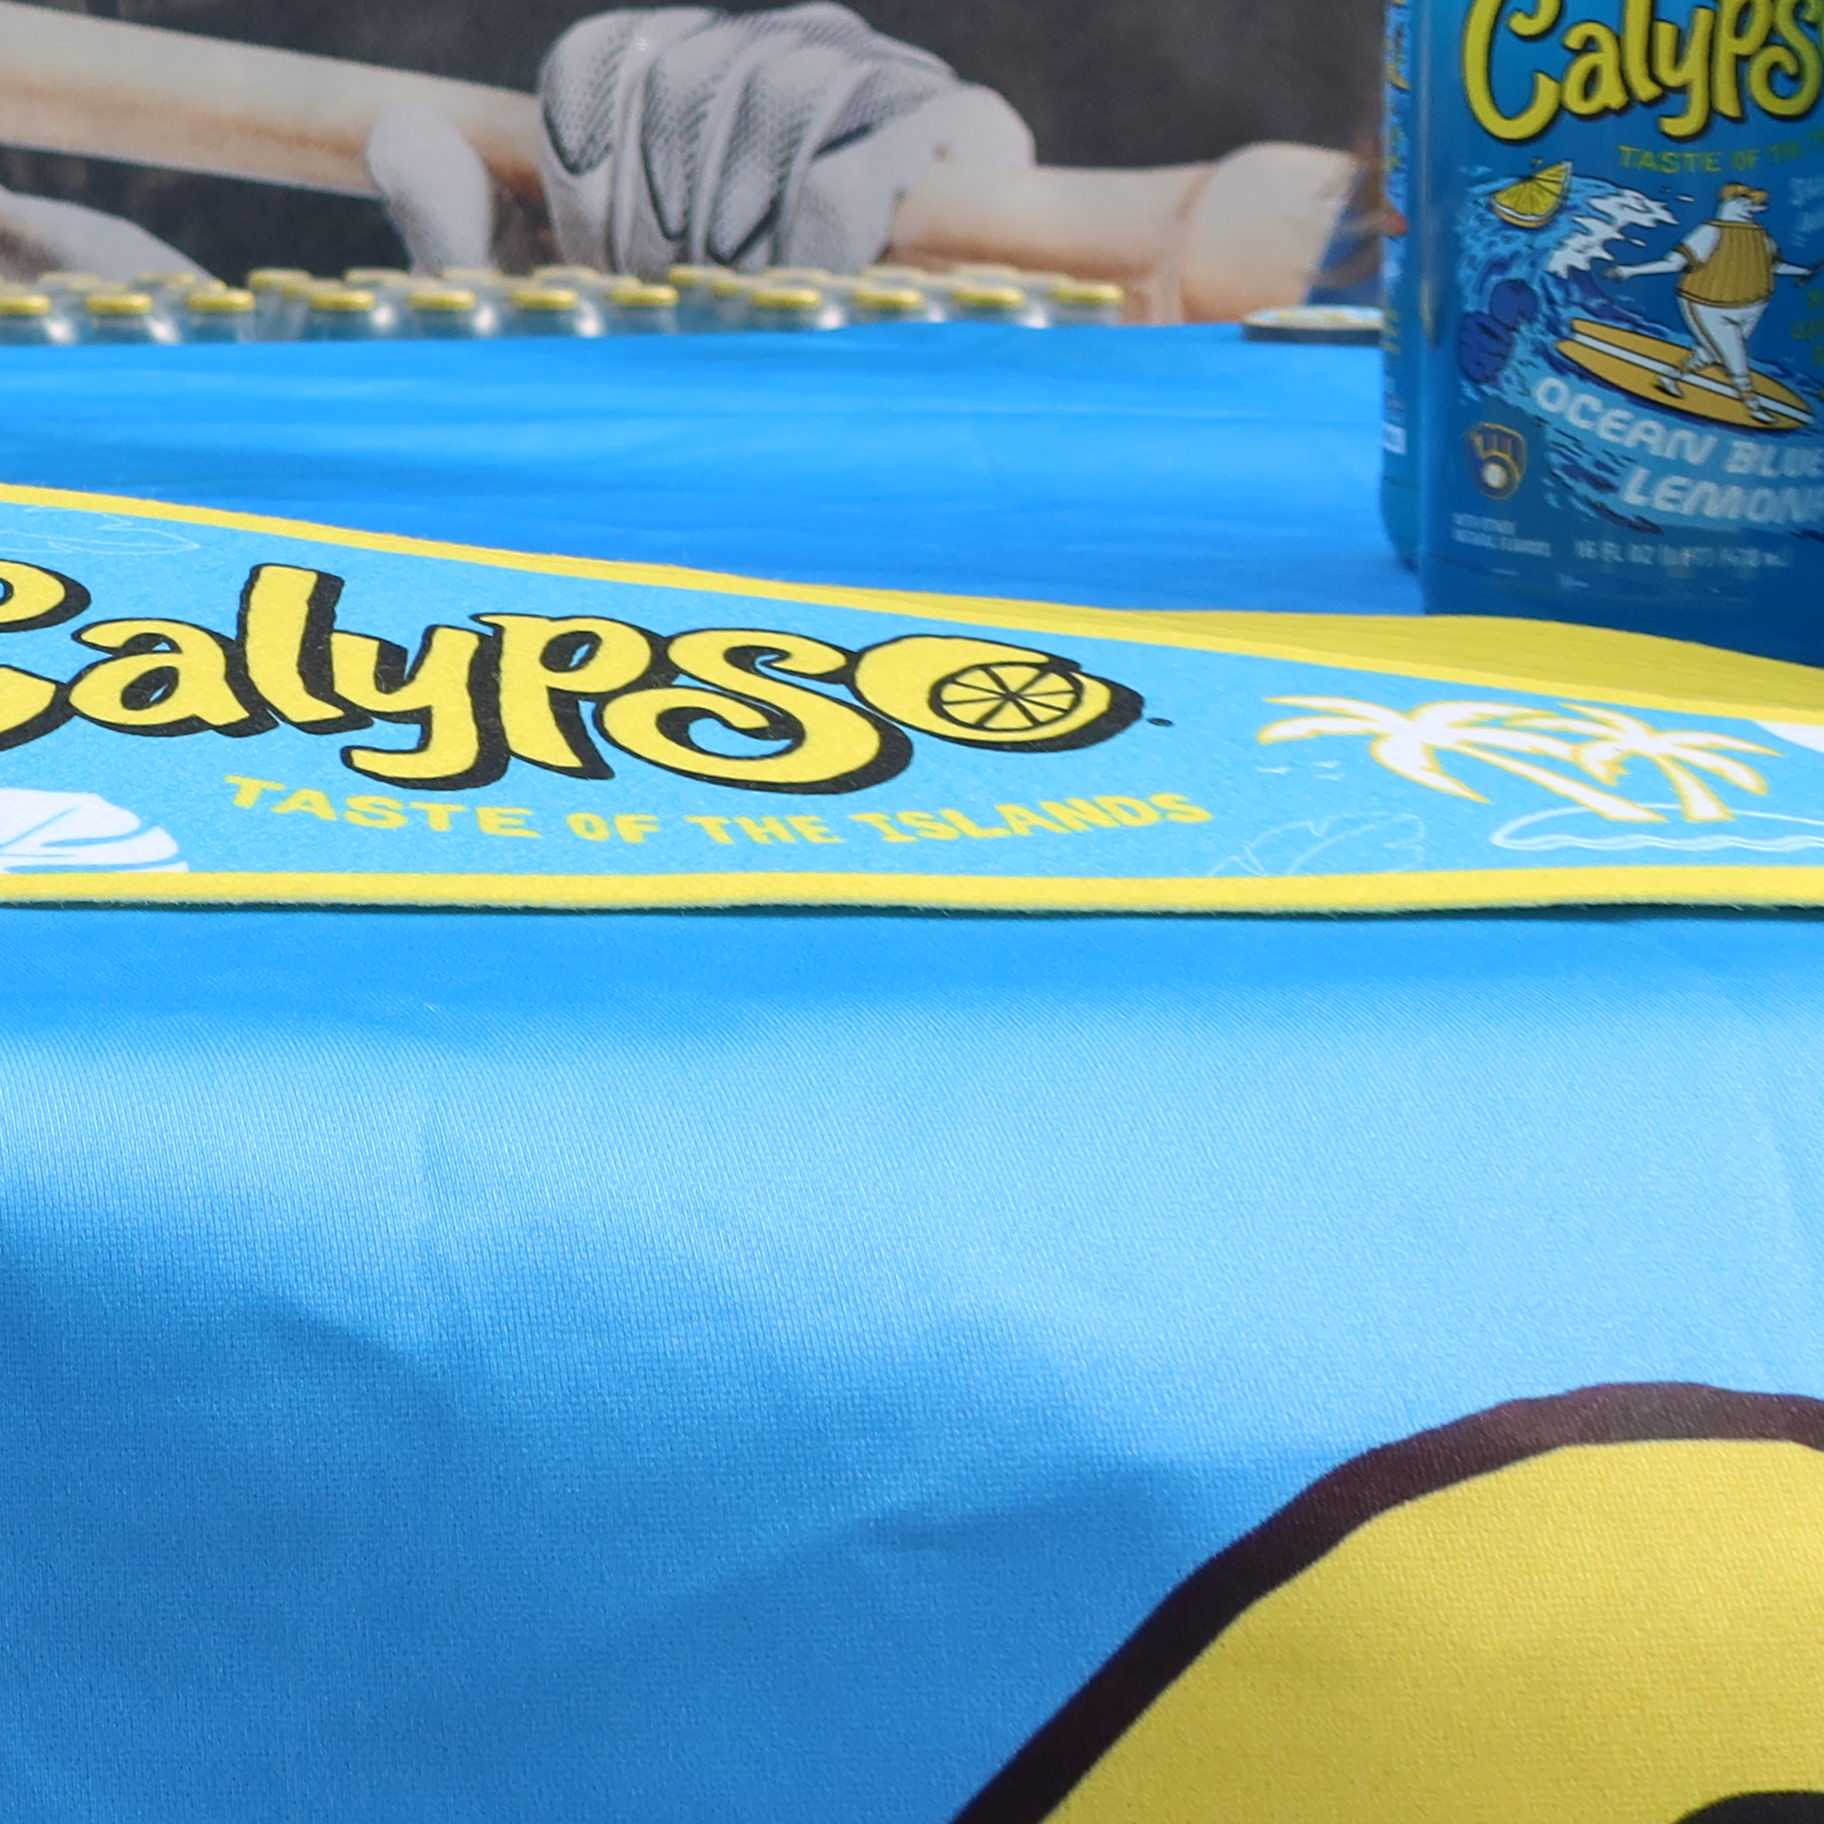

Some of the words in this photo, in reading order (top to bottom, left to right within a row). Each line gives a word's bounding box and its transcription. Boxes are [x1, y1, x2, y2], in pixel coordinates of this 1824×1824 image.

[1619, 144, 1722, 174] TASTE
[1533, 376, 1718, 466] OCEAN
[1623, 466, 1824, 526] LEMON
[224, 774, 542, 839] TASTE
[566, 812, 660, 844] OF
[685, 814, 845, 845] THE
[850, 792, 1213, 844] ISLANDS
